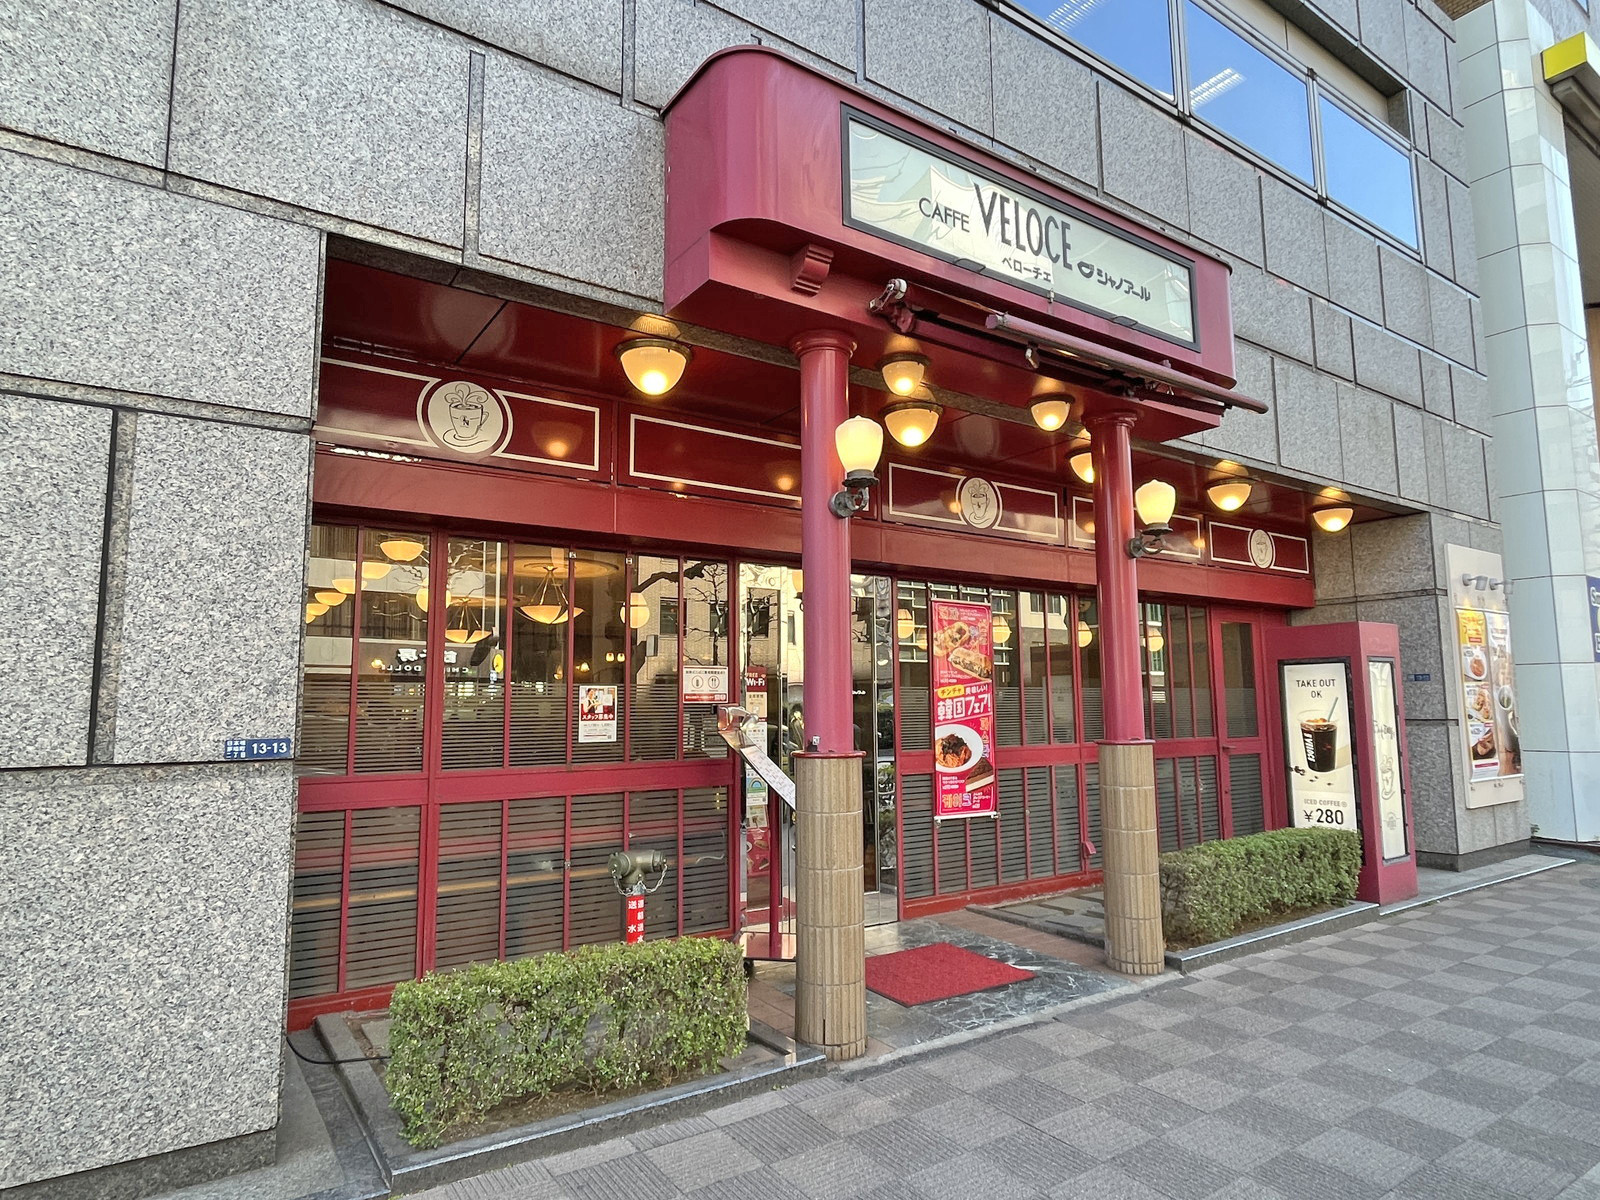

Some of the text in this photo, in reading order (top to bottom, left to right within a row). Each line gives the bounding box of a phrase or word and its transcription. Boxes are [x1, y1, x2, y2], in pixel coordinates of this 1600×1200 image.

[918, 182, 1073, 271] CAFFE VELOCE
[1001, 257, 1051, 283] ベローチェ
[1096, 268, 1151, 301] シャノアール
[1296, 678, 1336, 688] TAKE OUT
[1310, 690, 1322, 699] OK
[937, 693, 991, 721] 韓国フェア!
[251, 742, 287, 755] 13-13
[1304, 798, 1316, 806] ICED
[1318, 799, 1341, 807] COFFEE
